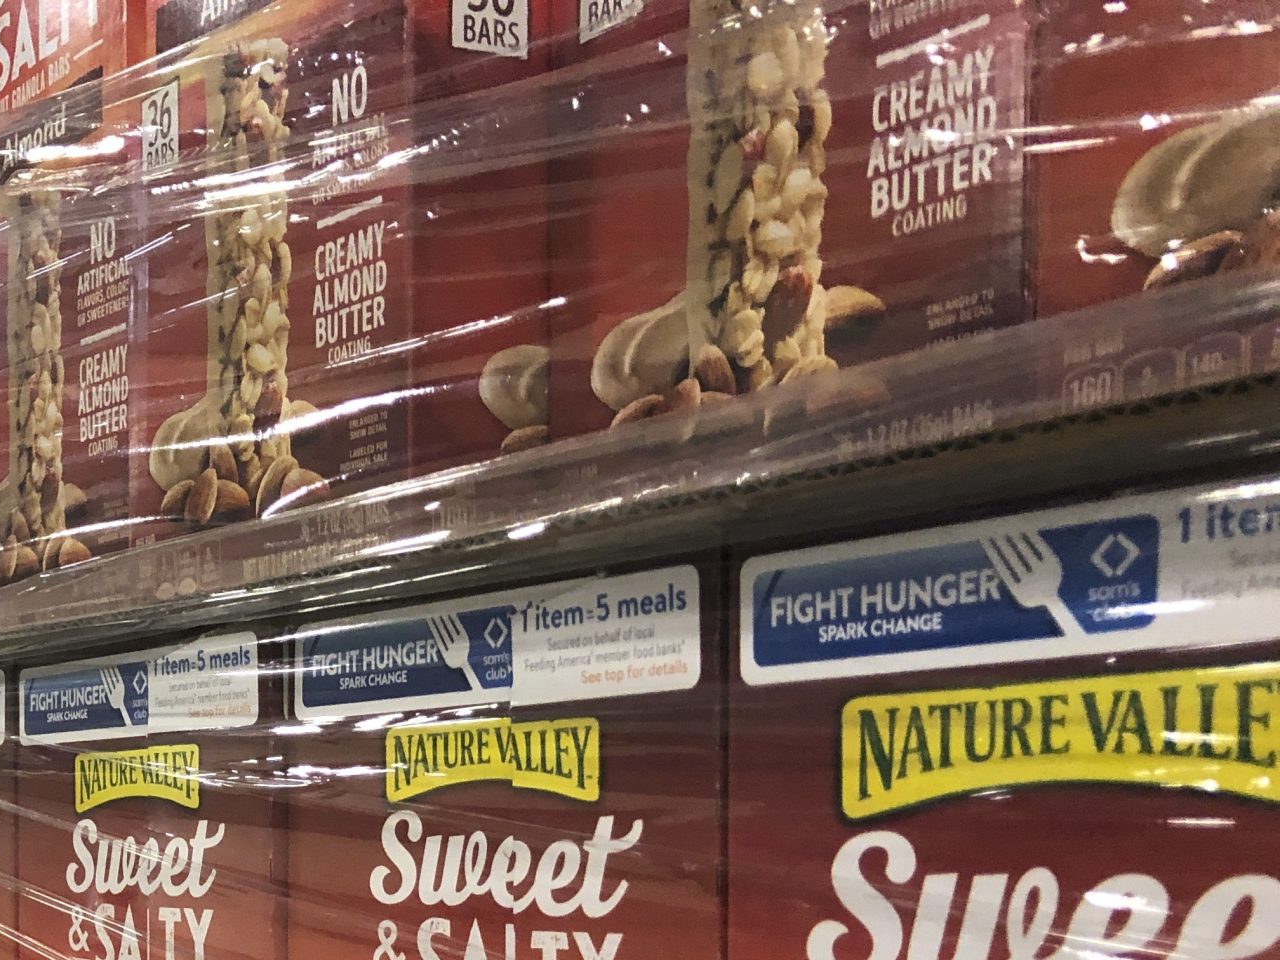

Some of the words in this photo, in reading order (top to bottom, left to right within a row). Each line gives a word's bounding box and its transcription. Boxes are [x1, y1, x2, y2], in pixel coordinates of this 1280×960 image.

[463, 13, 520, 48] BARS
[48, 53, 71, 86] BARS
[872, 46, 996, 133] CREAMY
[332, 65, 368, 127] NO
[2, 103, 68, 169] Almond
[148, 90, 172, 149] 36
[867, 97, 998, 177] ALMOND
[146, 138, 175, 171] BARS
[871, 148, 993, 219] BUTTER
[892, 195, 968, 238] COATING
[90, 216, 116, 264] NO
[314, 221, 385, 280] CREAMY
[77, 257, 132, 296] ARTIFICIAL
[313, 260, 387, 316] ALMOND
[315, 297, 385, 349] BUTTER
[79, 344, 128, 388] CREAMY
[328, 335, 372, 365] COATING
[78, 376, 128, 416] ALMOND
[79, 404, 127, 442] BUTTER
[88, 437, 119, 457] COATING
[1178, 506, 1191, 544] 1
[617, 583, 688, 619] meals
[770, 587, 853, 628] FIGHT
[860, 568, 1000, 616] HUNGER
[818, 617, 868, 644] SPARK
[871, 611, 943, 637] CHANGE
[209, 645, 251, 670] meals
[312, 650, 361, 679] FIGHT
[363, 638, 438, 671] HUNGER
[485, 667, 507, 682] club
[581, 670, 602, 684] See
[604, 668, 625, 684] top
[628, 664, 645, 679] for
[648, 659, 689, 677] details
[29, 692, 60, 713] FIGHT
[60, 684, 107, 707] HUNGER
[339, 674, 366, 691] SPARK
[368, 670, 408, 688] CHANGE
[46, 710, 64, 723] SPARK
[64, 708, 88, 721] CHANGE
[393, 726, 491, 794] NATURE
[494, 725, 593, 790] VALLEY
[858, 694, 1070, 800] NATURE
[1081, 679, 1280, 768] VALLE
[79, 756, 139, 805] NATURE
[139, 749, 196, 800] VALLEY
[66, 818, 226, 898] Sweet
[370, 810, 644, 918] Sweet
[69, 903, 90, 952] &
